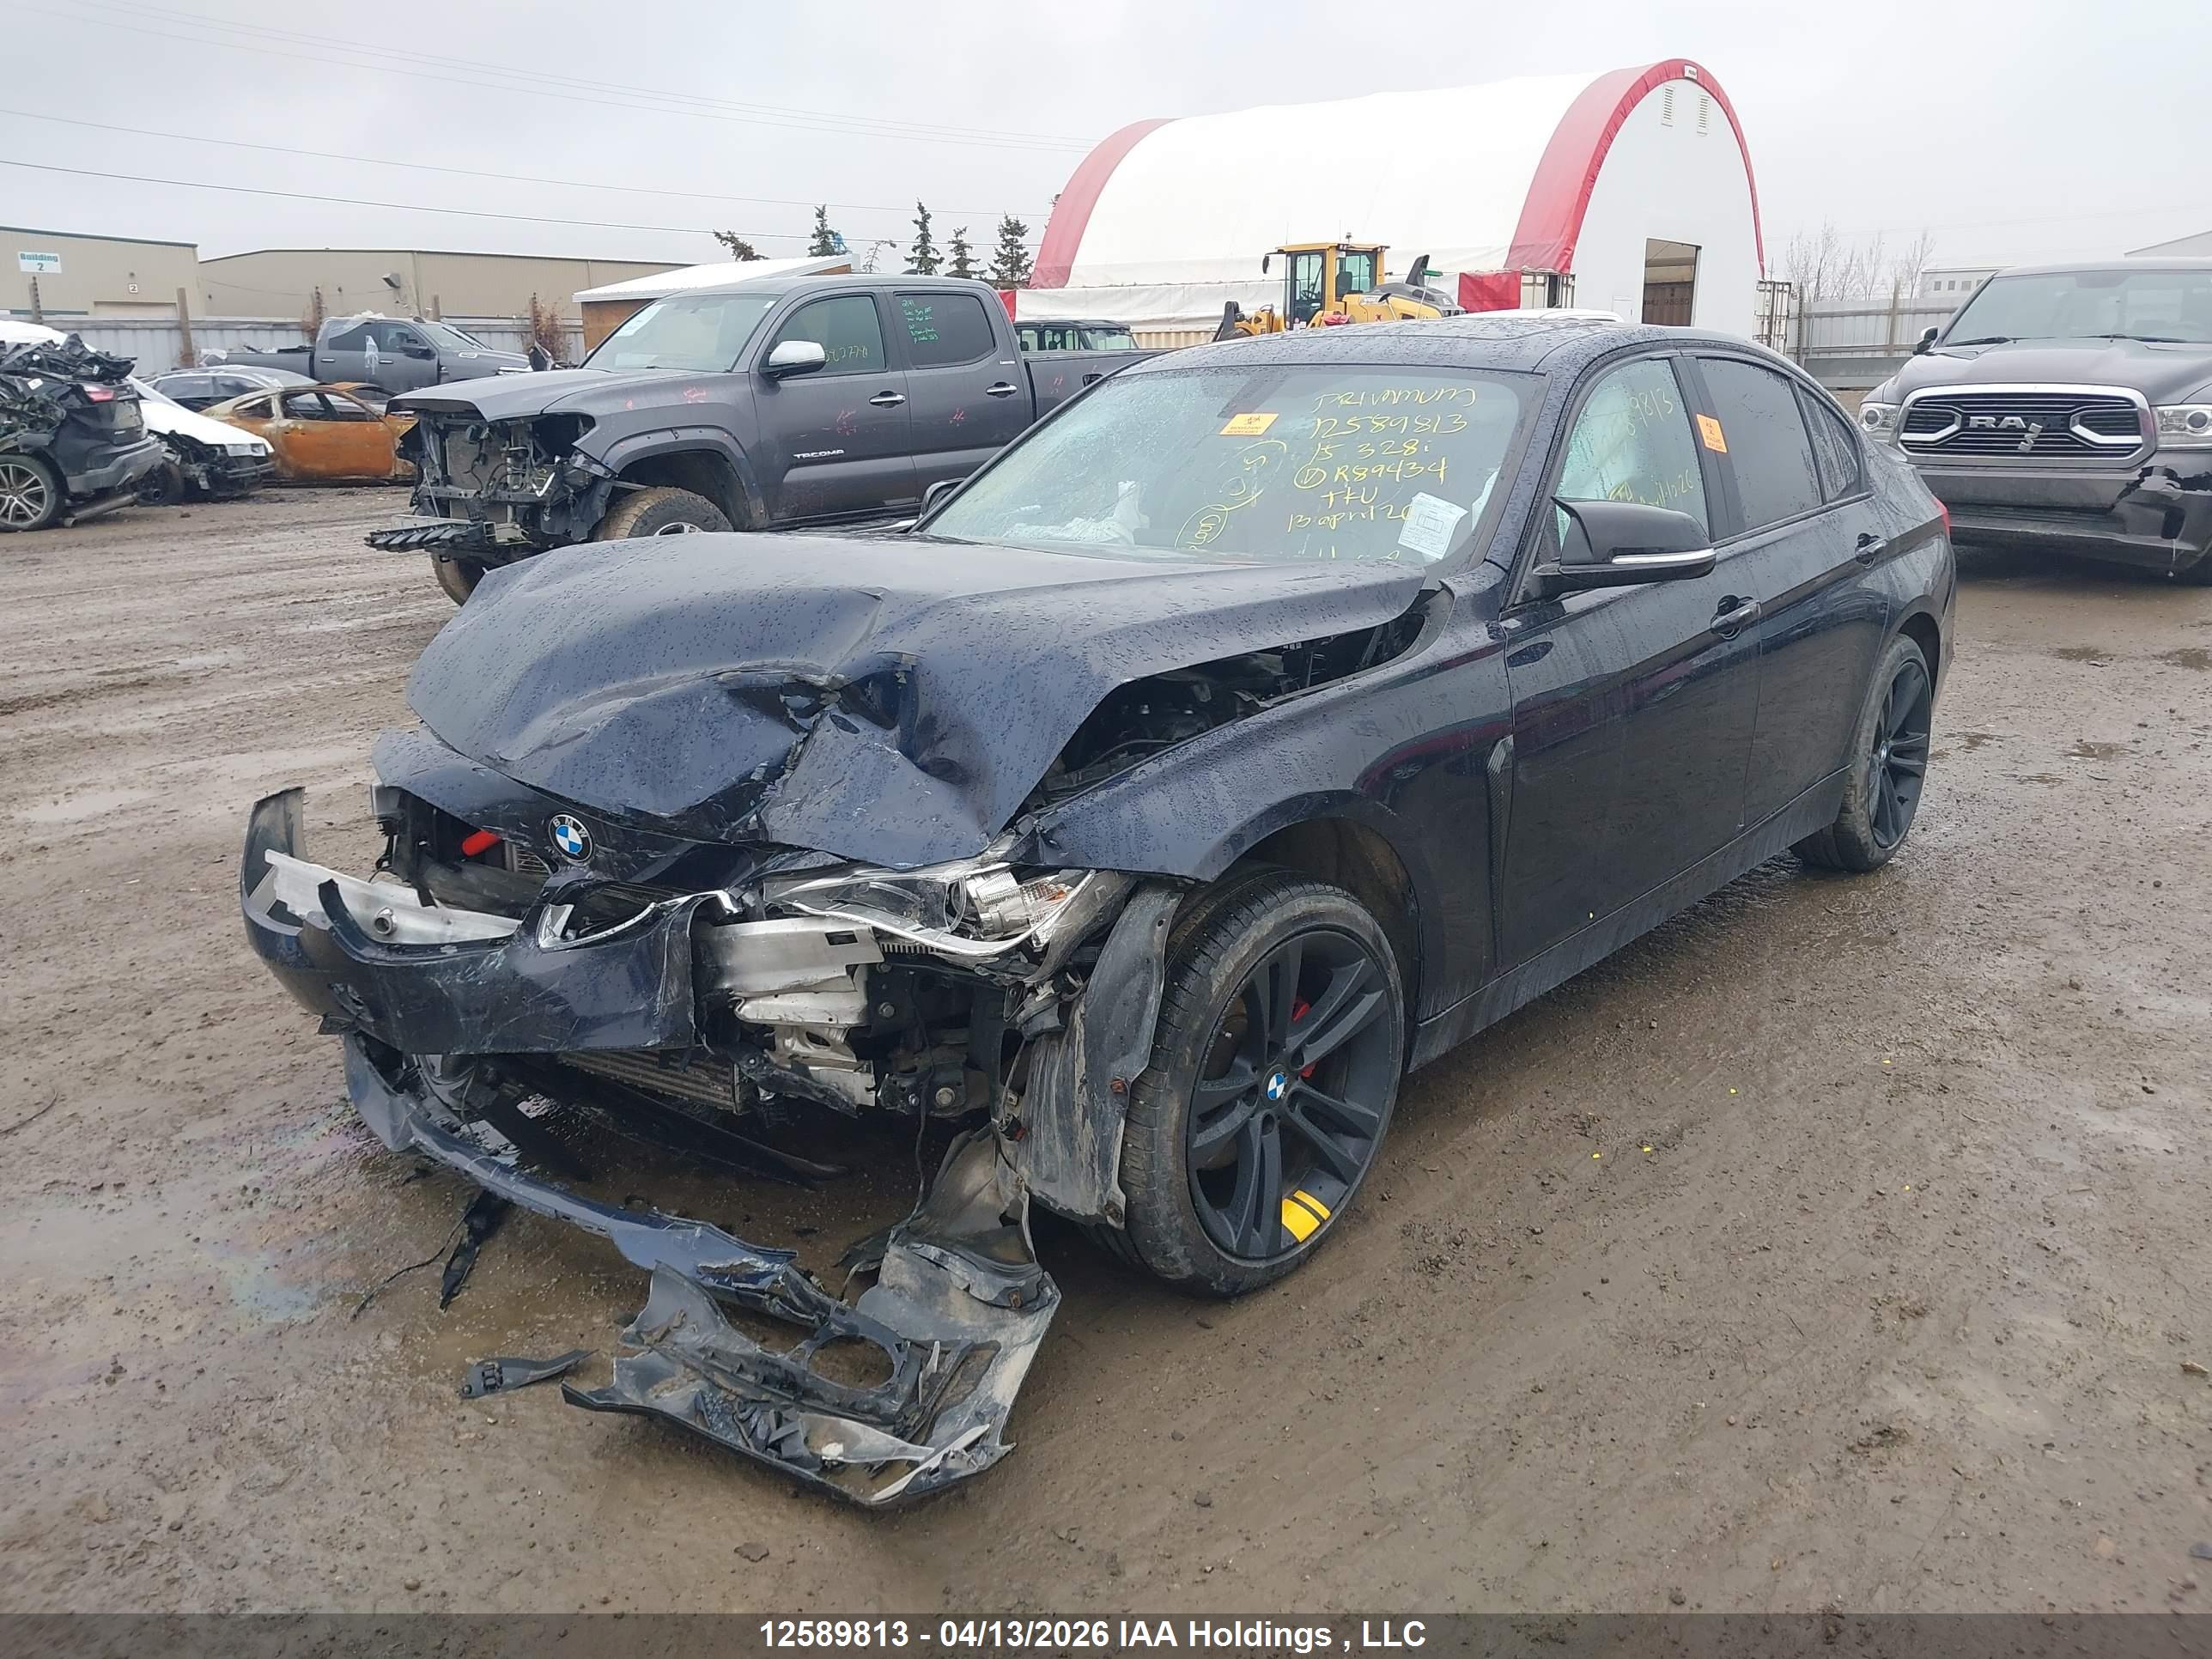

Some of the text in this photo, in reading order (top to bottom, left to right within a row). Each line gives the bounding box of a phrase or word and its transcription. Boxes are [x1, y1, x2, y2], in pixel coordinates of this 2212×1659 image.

[20, 252, 58, 263] Building
[37, 262, 45, 271] 2
[1310, 414, 1468, 440] 12589813
[793, 449, 845, 459] TACOMA
[552, 817, 589, 839] BMW
